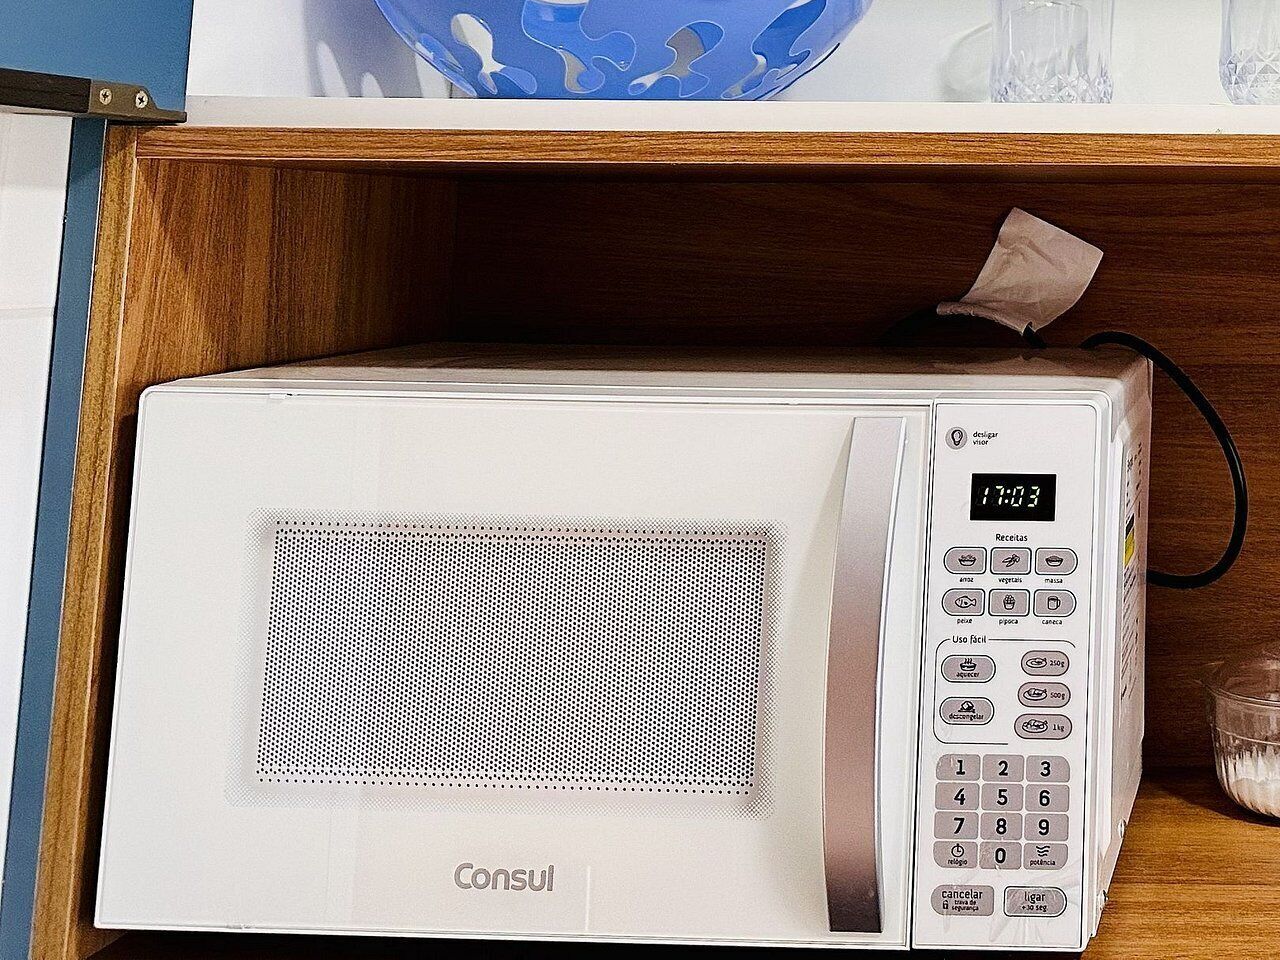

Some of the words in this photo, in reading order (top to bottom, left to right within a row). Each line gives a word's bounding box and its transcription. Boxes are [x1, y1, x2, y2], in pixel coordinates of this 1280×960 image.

[972, 431, 998, 440] desligar
[982, 485, 1040, 508] 17:03
[995, 533, 1028, 542] Receitas
[998, 577, 1022, 585] vegetais
[952, 635, 968, 644] Uso
[969, 634, 987, 644] fácil
[948, 713, 984, 721] descongelar
[956, 759, 966, 776] 1
[998, 760, 1008, 776] 2
[1040, 761, 1051, 777] 3
[953, 787, 966, 805] 4
[996, 788, 1008, 806] 5
[1039, 789, 1050, 807] 6
[953, 817, 965, 834] 7
[995, 817, 1007, 835] 8
[1038, 818, 1050, 836] 9
[947, 859, 968, 867] relógio
[995, 847, 1006, 864] 0
[1029, 859, 1056, 867] potência
[454, 862, 555, 892] Consul
[942, 889, 983, 899] cancelar
[1024, 891, 1046, 904] ligar
